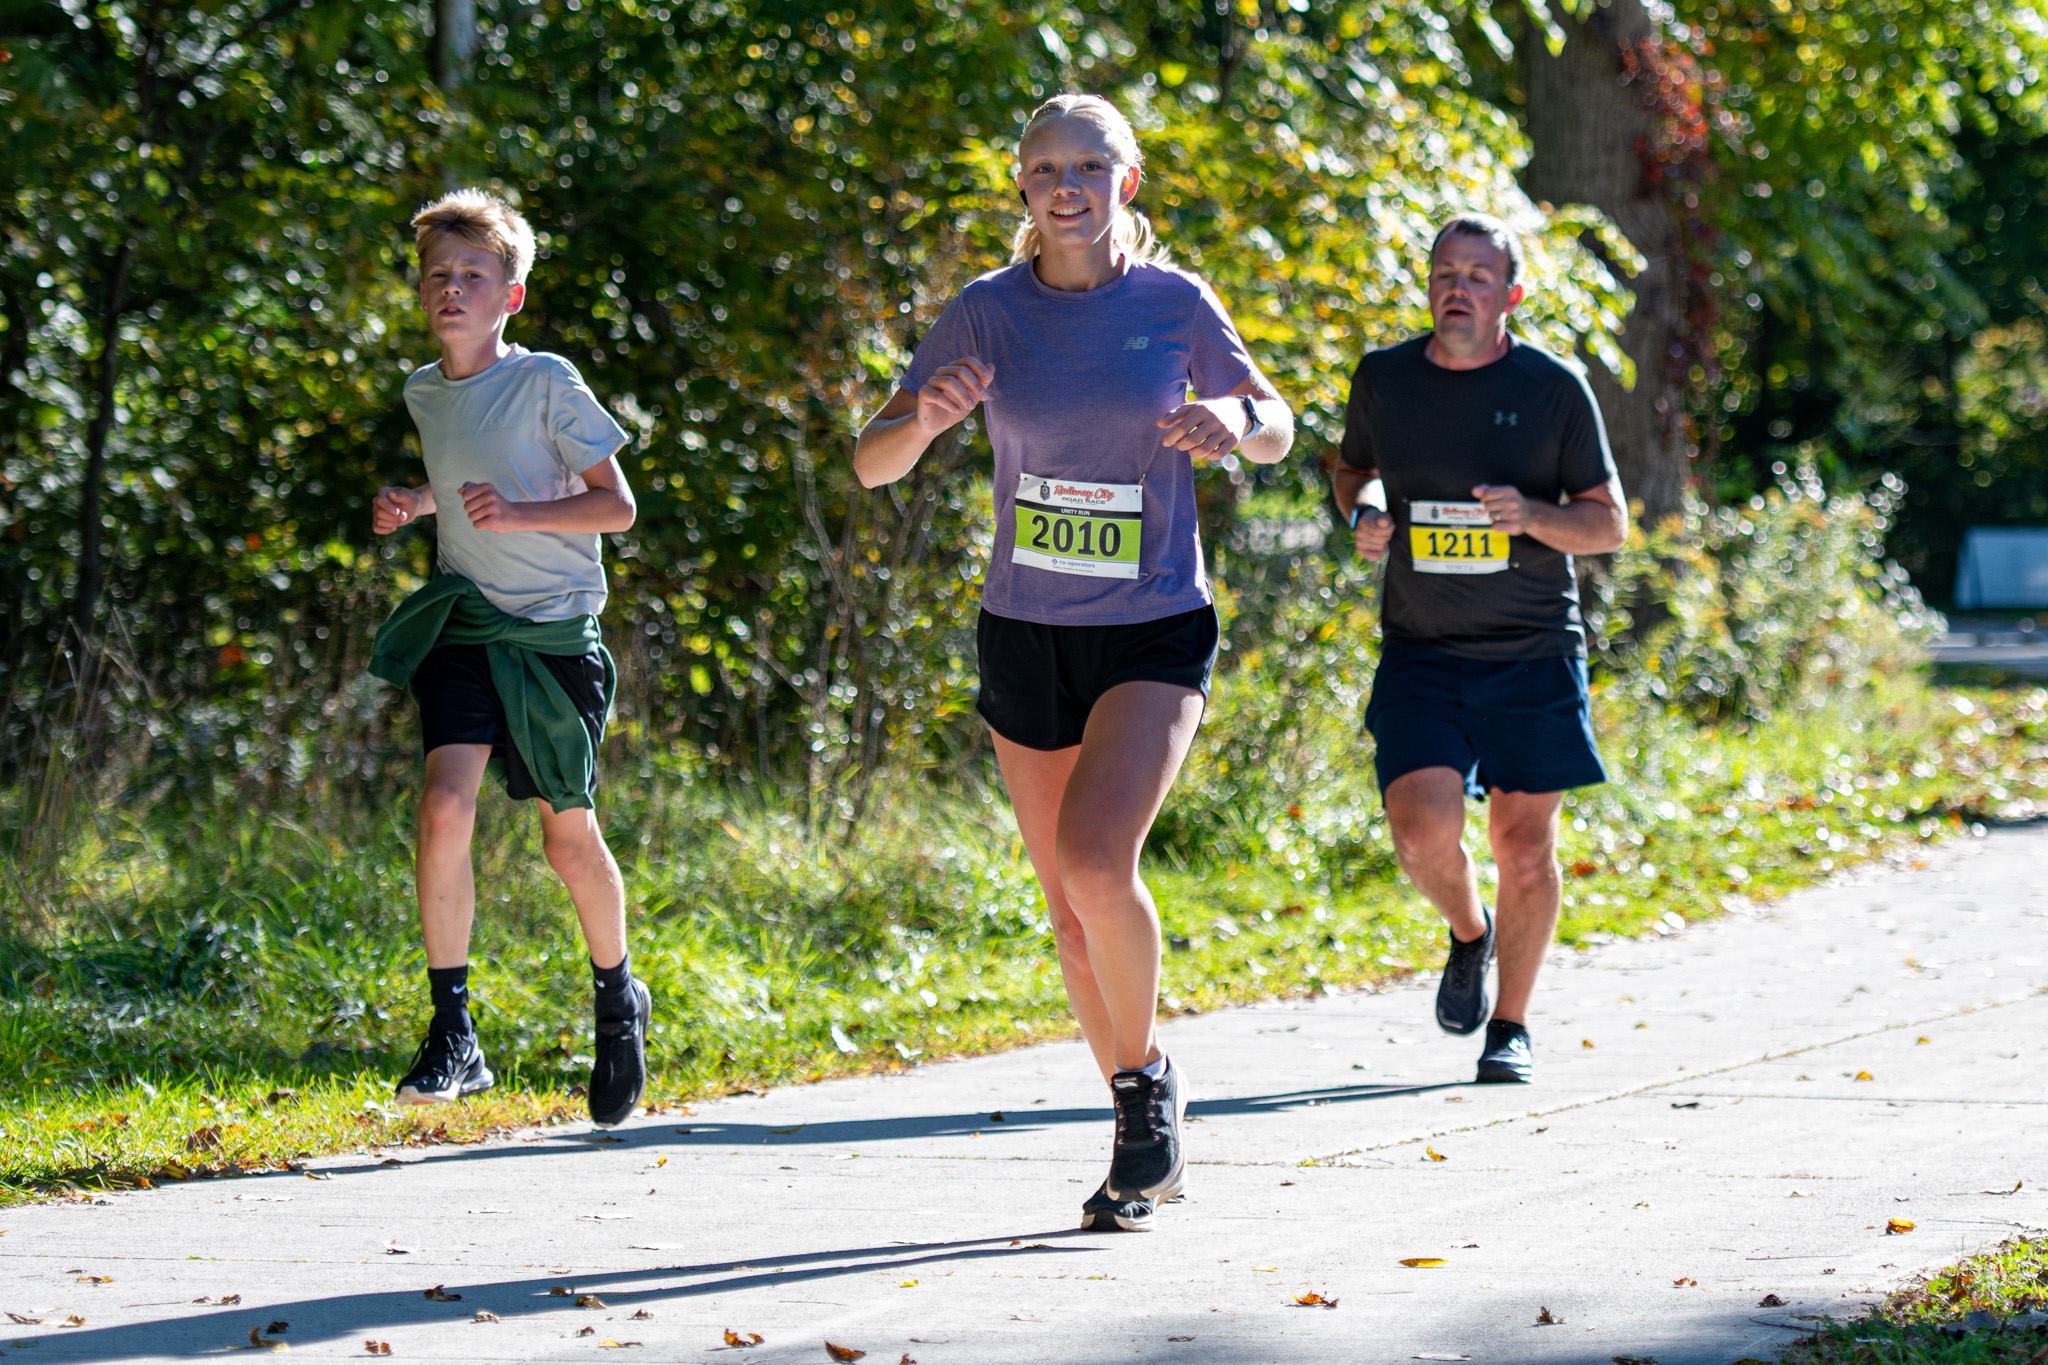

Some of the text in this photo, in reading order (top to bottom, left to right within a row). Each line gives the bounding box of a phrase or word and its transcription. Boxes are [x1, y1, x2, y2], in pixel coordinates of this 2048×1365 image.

[1054, 484, 1115, 502] Railway City
[1031, 514, 1122, 557] 2010
[1428, 532, 1493, 557] 1211
[1059, 560, 1096, 569] co-operators
